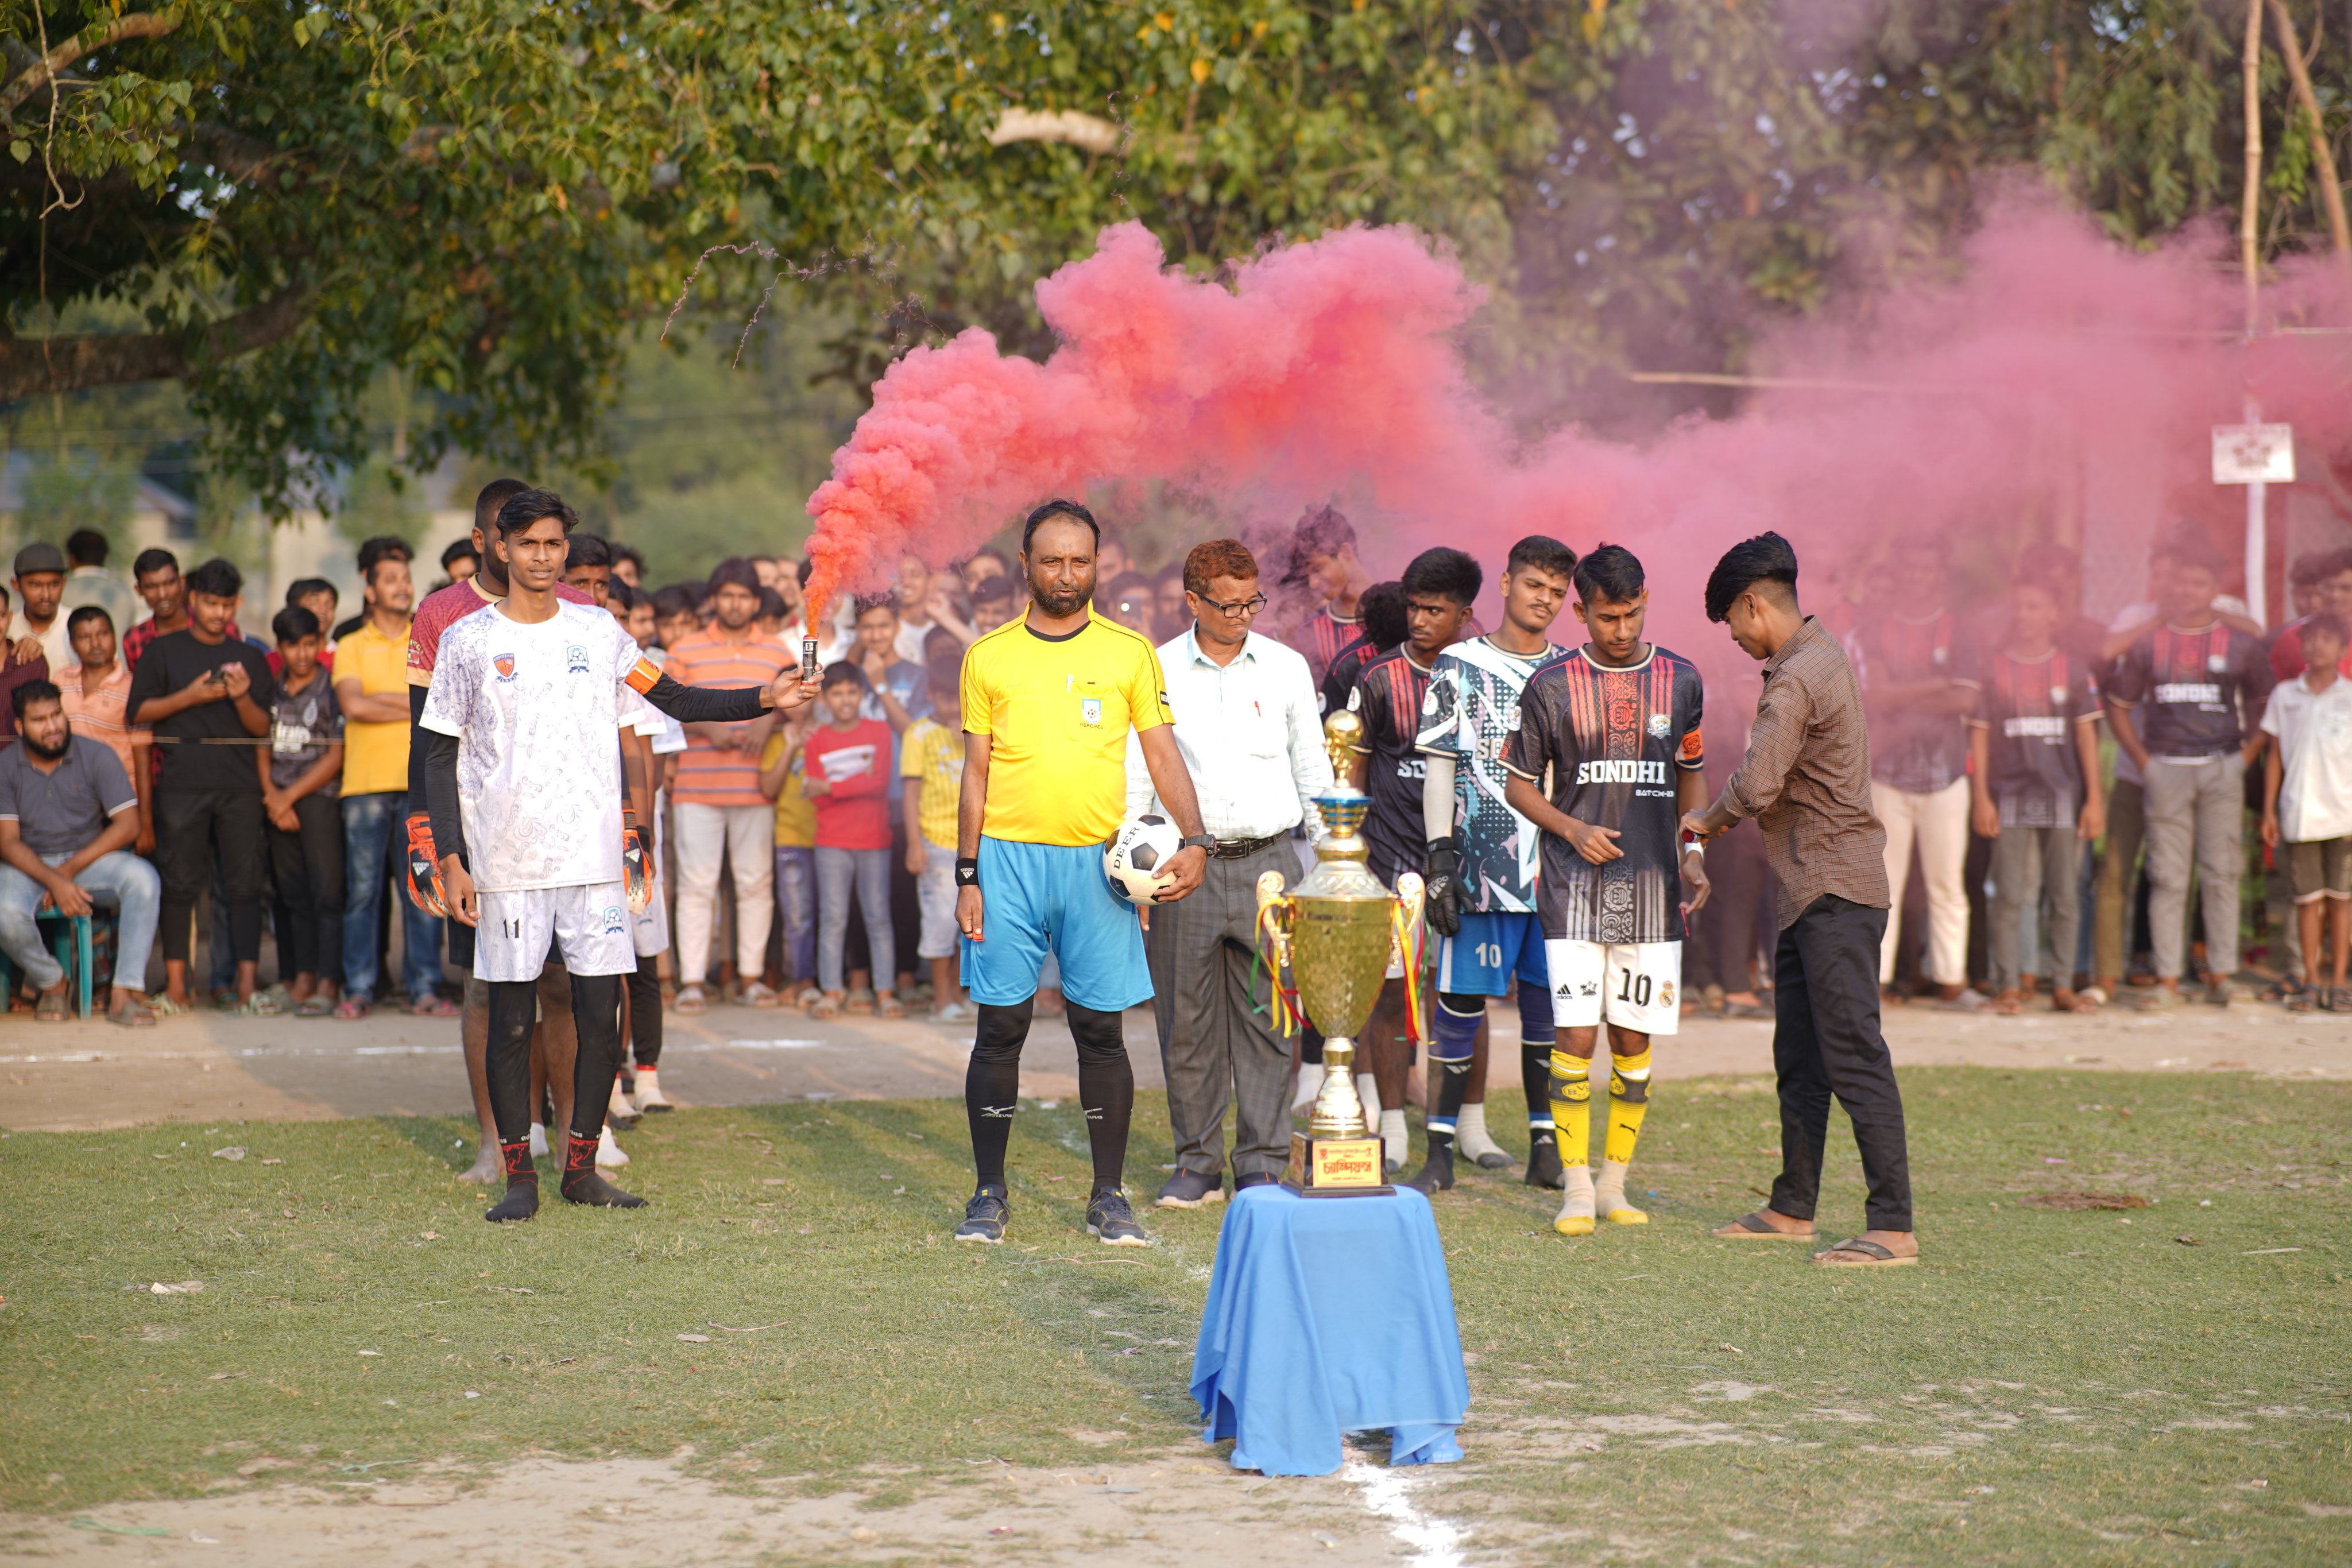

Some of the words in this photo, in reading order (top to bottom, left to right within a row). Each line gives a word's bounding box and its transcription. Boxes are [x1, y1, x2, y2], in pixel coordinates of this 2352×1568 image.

[1576, 760, 1665, 784] SONDHI
[1114, 827, 1140, 870] DEER
[503, 918, 519, 938] 11
[1475, 942, 1502, 968] 10
[1617, 967, 1651, 1006] 10
